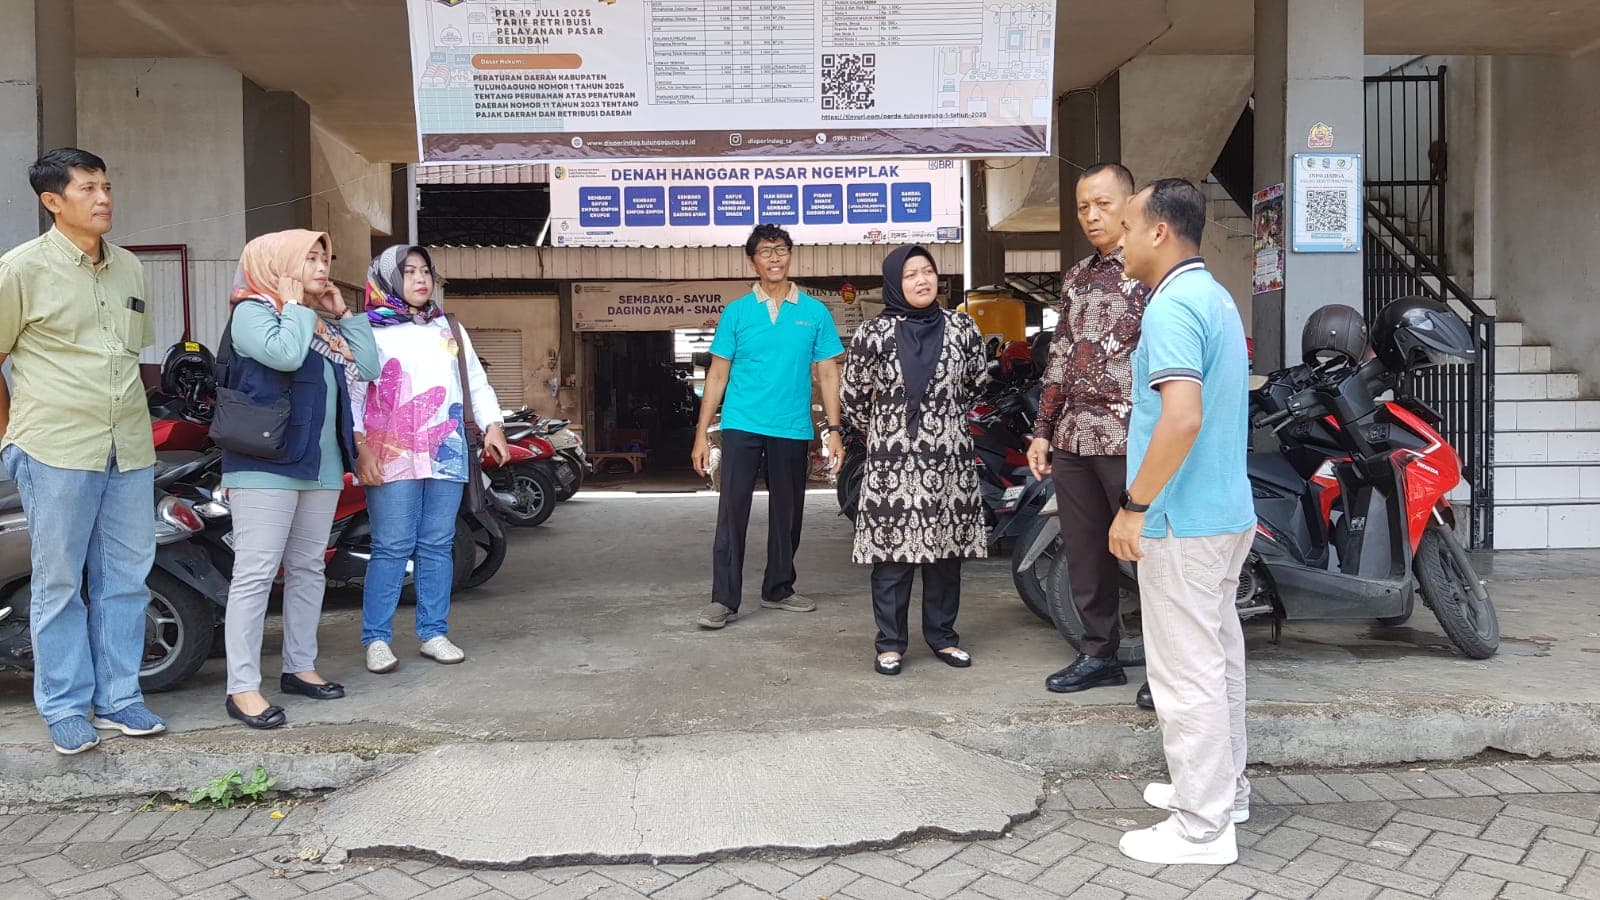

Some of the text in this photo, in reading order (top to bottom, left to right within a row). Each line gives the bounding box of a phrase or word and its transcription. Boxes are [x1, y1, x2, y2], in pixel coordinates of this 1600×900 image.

[939, 160, 954, 168] BRI
[612, 168, 667, 181] DENAH
[672, 168, 749, 180] HANGGAR
[754, 167, 807, 180] PASAR
[812, 166, 899, 178] NGEMPLAK
[619, 295, 673, 304] SEMBAKO
[684, 294, 721, 303] SAYUR
[608, 307, 650, 315] DAGING
[653, 306, 684, 314] AYAM
[694, 305, 725, 314] SNAC
[1417, 461, 1439, 475] HONDA
